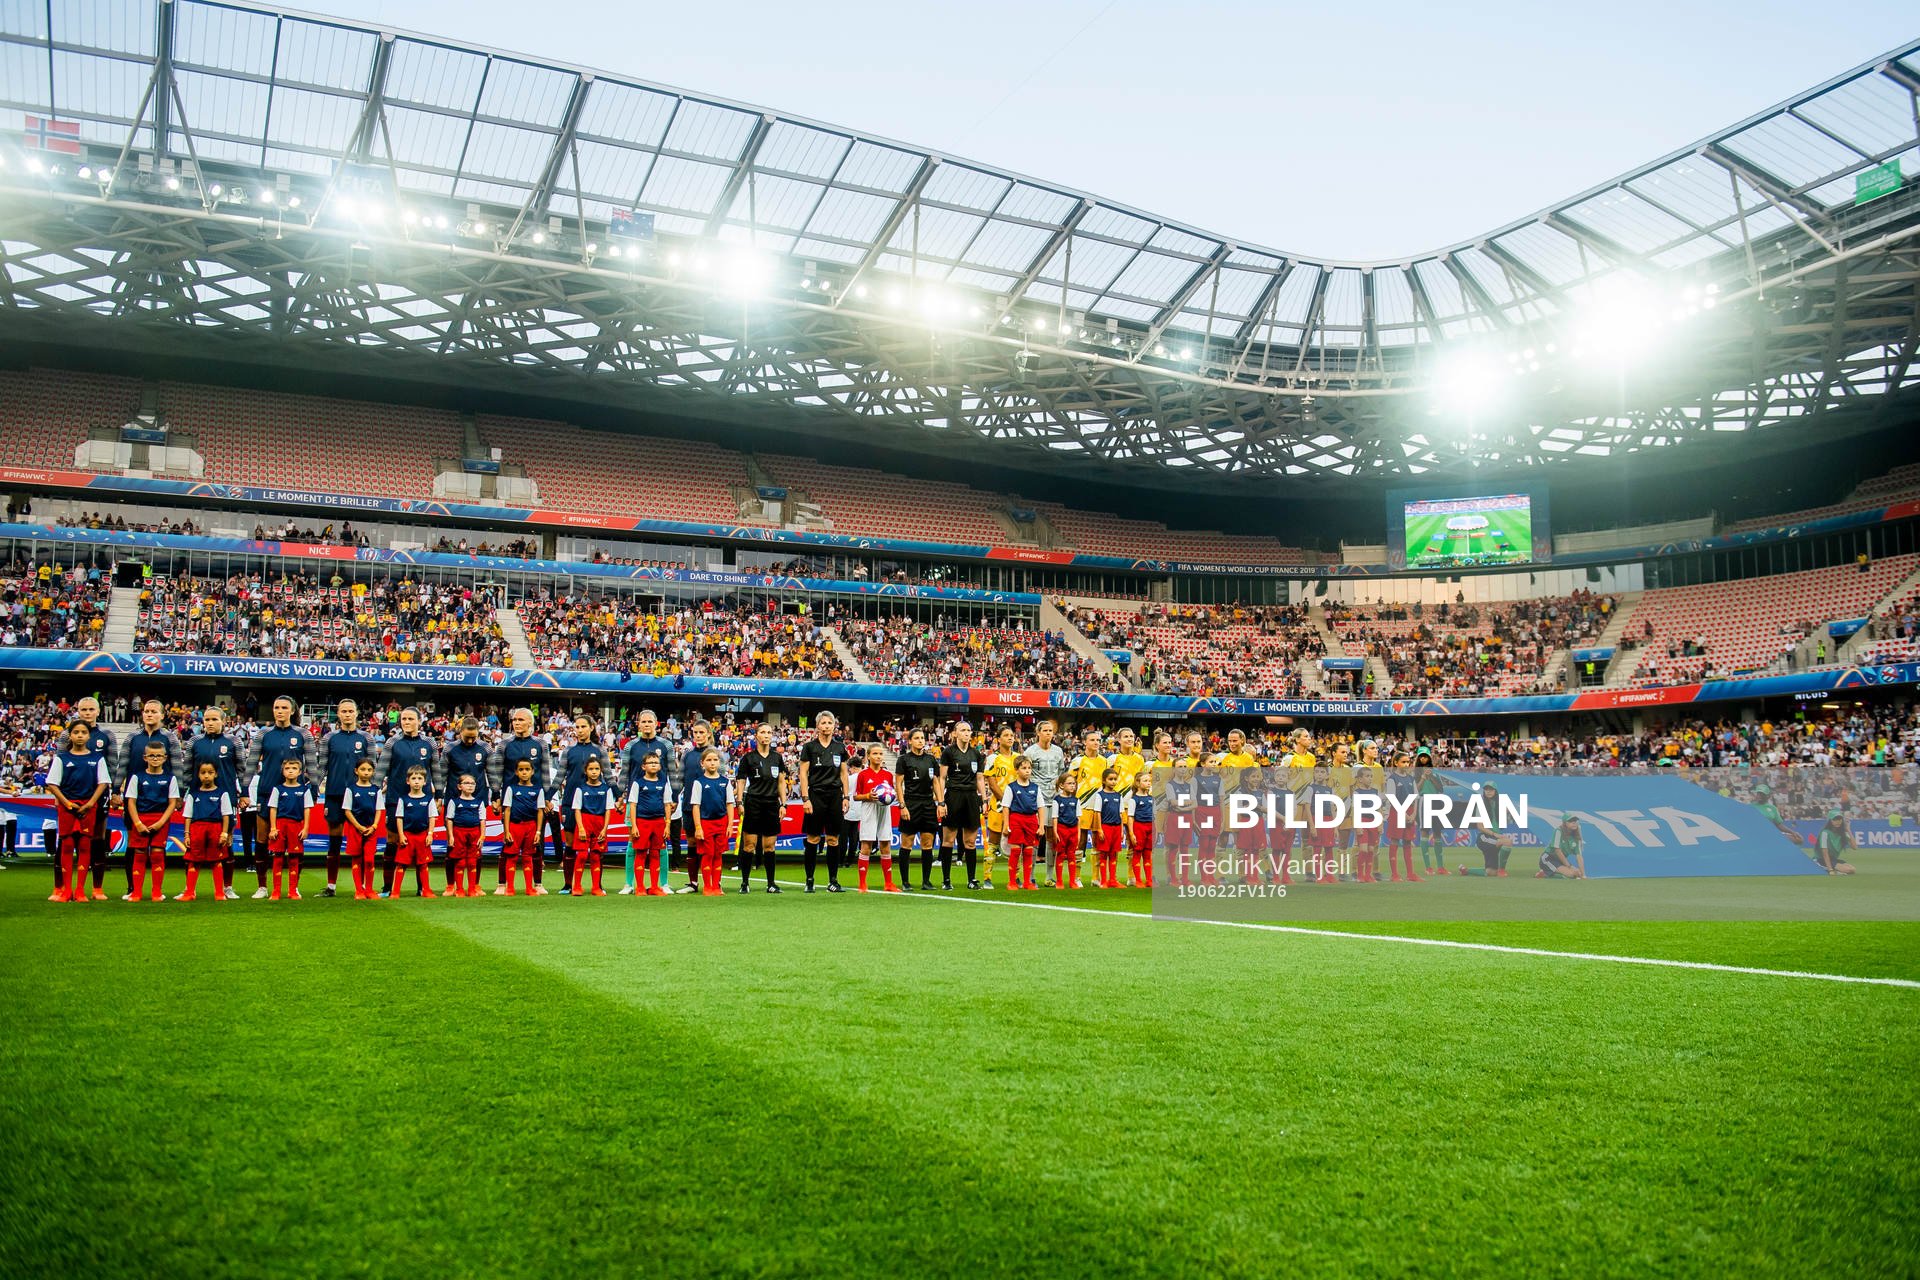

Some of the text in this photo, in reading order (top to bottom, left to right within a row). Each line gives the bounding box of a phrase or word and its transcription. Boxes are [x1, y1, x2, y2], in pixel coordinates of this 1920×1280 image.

[3, 471, 46, 480] #FIFAWWC
[263, 491, 275, 499] LE
[277, 492, 322, 503] MOMENT
[325, 496, 338, 504] DE
[568, 516, 601, 525] #FIFAWWC
[309, 546, 331, 555] NICE
[1177, 563, 1192, 571] FIFA
[1193, 564, 1226, 572] WOMEN'S
[1227, 565, 1253, 573] WORLD
[1270, 566, 1298, 574] FRANCE
[690, 572, 711, 581] DARE
[712, 574, 722, 582] TO
[185, 659, 216, 672] FIFA
[219, 661, 290, 675] WOMEN'S
[293, 664, 346, 677] WORLD
[349, 666, 378, 678] CUP
[381, 667, 434, 680] FRANCE
[712, 682, 757, 692] #FIFAWWC
[999, 692, 1023, 703] NICE
[1254, 702, 1265, 711] LE
[1267, 702, 1309, 713] MOMENT
[1311, 704, 1326, 713] DE
[996, 766, 1007, 777] 20
[1080, 768, 1087, 778] 6
